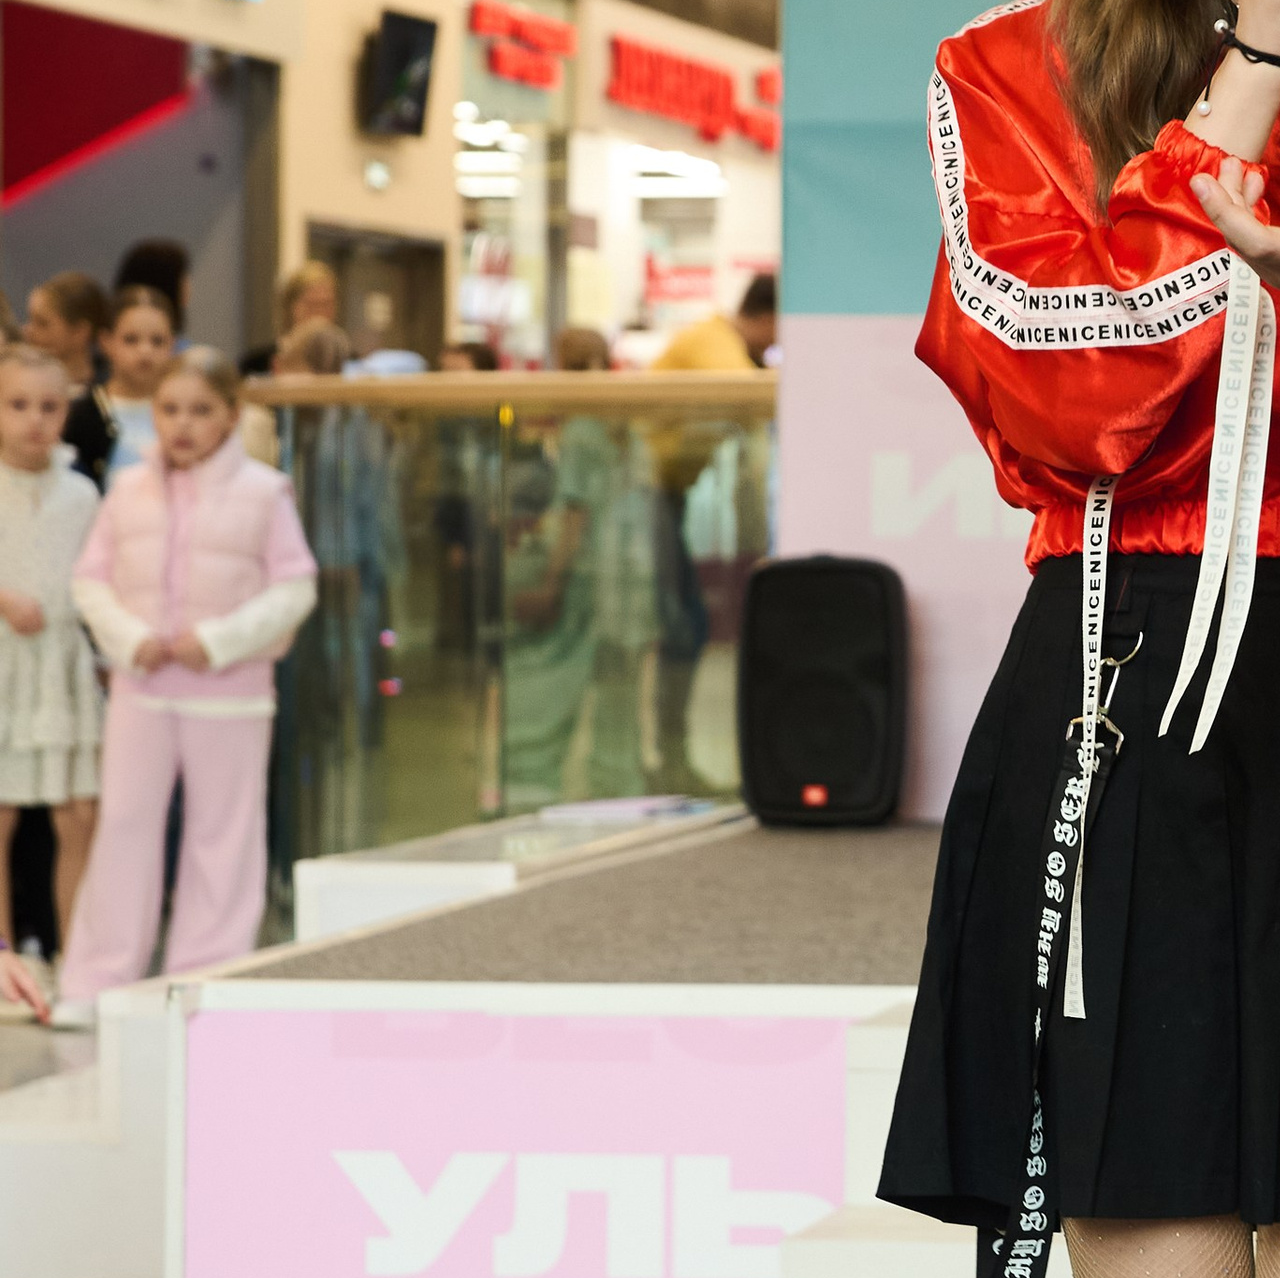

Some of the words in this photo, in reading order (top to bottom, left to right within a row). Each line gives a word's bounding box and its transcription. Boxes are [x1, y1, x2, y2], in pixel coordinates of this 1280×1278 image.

[1043, 850, 1067, 903] SO
[1036, 906, 1063, 990] WHY
[1018, 1185, 1048, 1233] SO
